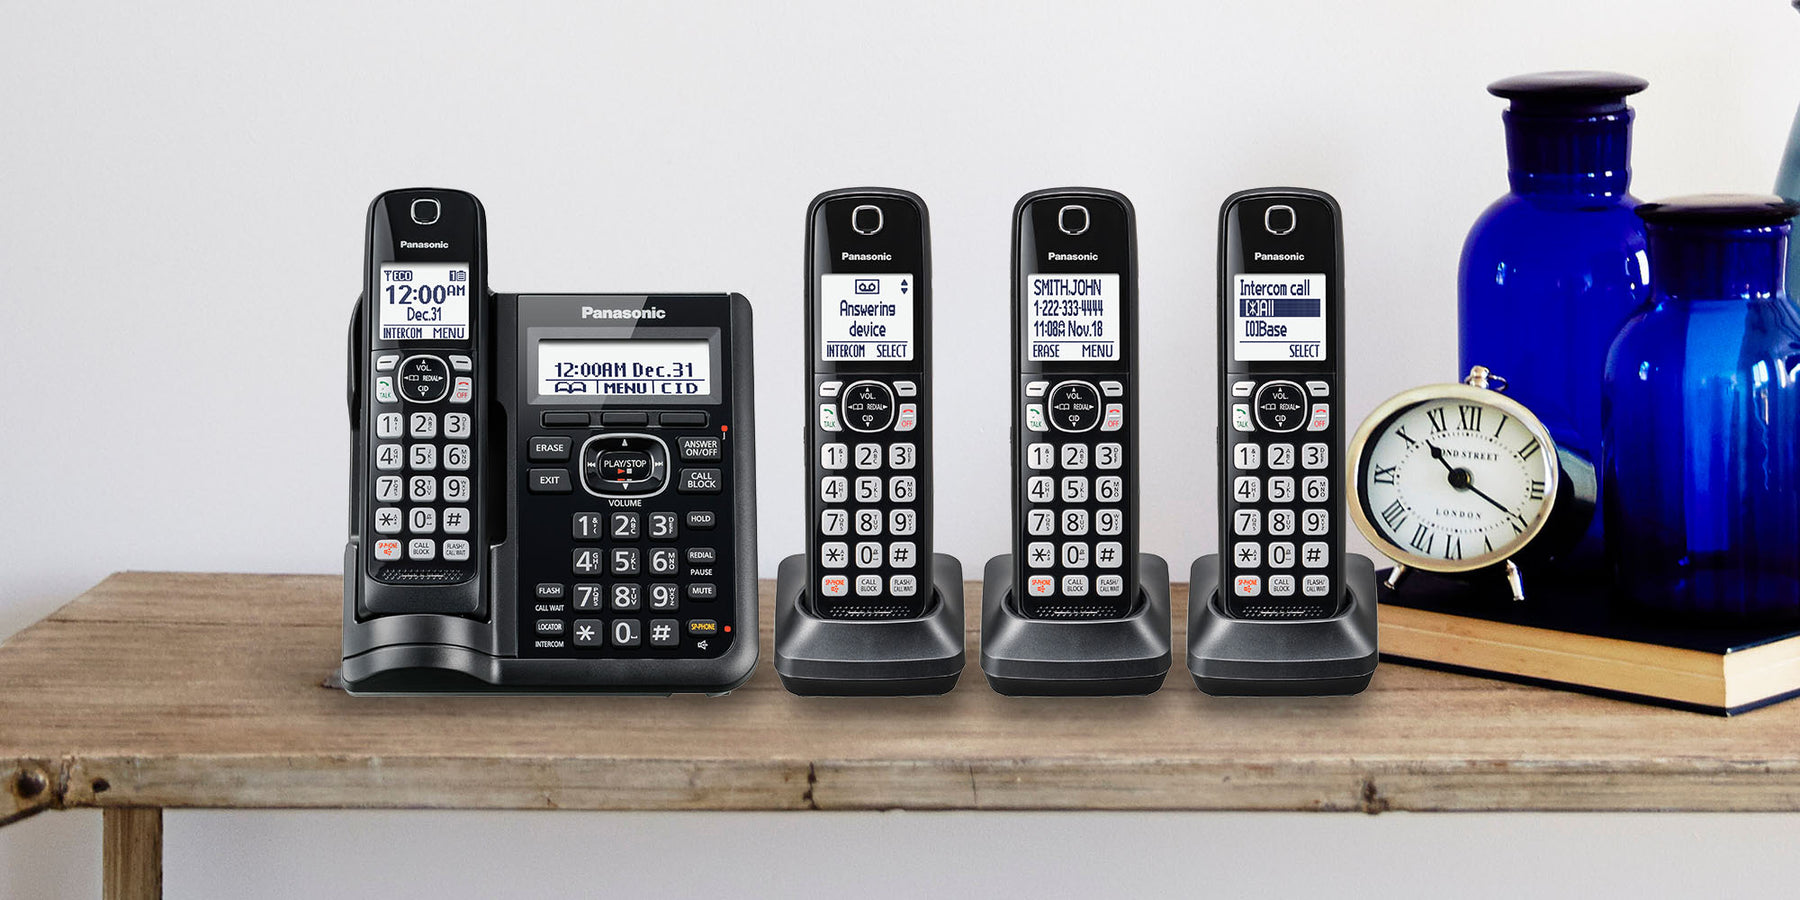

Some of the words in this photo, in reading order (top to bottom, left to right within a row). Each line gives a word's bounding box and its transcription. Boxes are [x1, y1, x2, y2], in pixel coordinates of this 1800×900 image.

[400, 240, 449, 249] Panasonic
[841, 252, 892, 261] Panasonic
[1048, 252, 1099, 261] Panasonic
[1254, 252, 1305, 261] Panasonic
[1240, 278, 1288, 296] Intercom
[1290, 278, 1310, 296] call
[407, 307, 442, 322] Dec.31
[581, 306, 666, 320] Panasonic
[840, 300, 896, 316] Answering
[1034, 300, 1104, 316] 1-222-333-4444
[383, 327, 423, 339] INTERCOM
[433, 327, 465, 339] MENU
[849, 320, 886, 337] device
[1068, 320, 1103, 337] Nov.18
[826, 344, 866, 358] INTERCOM
[876, 344, 908, 358] SELECT
[1033, 344, 1060, 358] ERASE
[1082, 344, 1113, 358] MENU
[1290, 344, 1320, 358] SELECT
[554, 362, 627, 378] 12:00AM
[632, 362, 693, 378] Dec.31
[604, 382, 647, 394] MENU
[661, 382, 698, 394] CID
[415, 415, 427, 432] 2
[448, 415, 461, 433] 3
[1426, 406, 1447, 434] XI
[1456, 405, 1482, 432] XII
[536, 443, 564, 452] ERASE
[684, 440, 718, 448] ANSWER
[686, 448, 718, 456] ON/OFF
[380, 448, 394, 464] 4
[415, 448, 426, 465] 5
[448, 448, 461, 465] 6
[603, 459, 647, 468] PLAY/STOP
[860, 447, 872, 465] 2
[894, 446, 906, 465] 3
[1067, 447, 1079, 465] 2
[1101, 446, 1113, 465] 3
[1273, 447, 1285, 465] 2
[1308, 446, 1319, 465] 3
[1438, 448, 1460, 459] OND
[1461, 450, 1499, 462] STREET
[540, 476, 560, 484] EXIT
[687, 480, 716, 488] BLOCK
[690, 472, 712, 480] CALL
[381, 479, 394, 497] 7
[414, 479, 426, 497] 8
[448, 479, 460, 497] 9
[826, 480, 838, 498] 4
[861, 480, 872, 498] 5
[895, 480, 906, 498] 6
[1032, 480, 1045, 498] 4
[1068, 480, 1079, 498] 5
[1102, 480, 1113, 498] 6
[1238, 480, 1252, 498] 4
[1274, 480, 1285, 498] 5
[1308, 480, 1320, 498] 6
[414, 510, 426, 528] 0
[690, 515, 711, 523] HOLD
[827, 513, 838, 532] 7
[860, 513, 872, 532] 8
[895, 513, 906, 532] 9
[1034, 513, 1045, 532] 7
[1067, 513, 1079, 532] 8
[1102, 513, 1113, 532] 9
[1240, 513, 1252, 532] 7
[1274, 513, 1286, 532] 8
[1308, 513, 1320, 532] 9
[1435, 508, 1482, 520] LONDON
[614, 515, 630, 536] 2
[652, 515, 668, 536] 3
[576, 551, 592, 572] 4
[615, 551, 630, 572] 5
[652, 551, 668, 572] 6
[689, 552, 713, 560] REDIAL
[861, 546, 872, 564] 0
[1068, 546, 1079, 564] 0
[1274, 546, 1286, 564] 0
[690, 568, 712, 576] PAUSE
[538, 586, 561, 594] FLASH
[577, 586, 592, 607] 7
[614, 586, 630, 607] 8
[652, 586, 668, 607] 9
[692, 586, 712, 594] MUTE
[535, 604, 549, 612] CALL
[549, 604, 564, 612] WAIT
[538, 623, 562, 631] LOCATOR
[535, 640, 564, 648] INTERCOM
